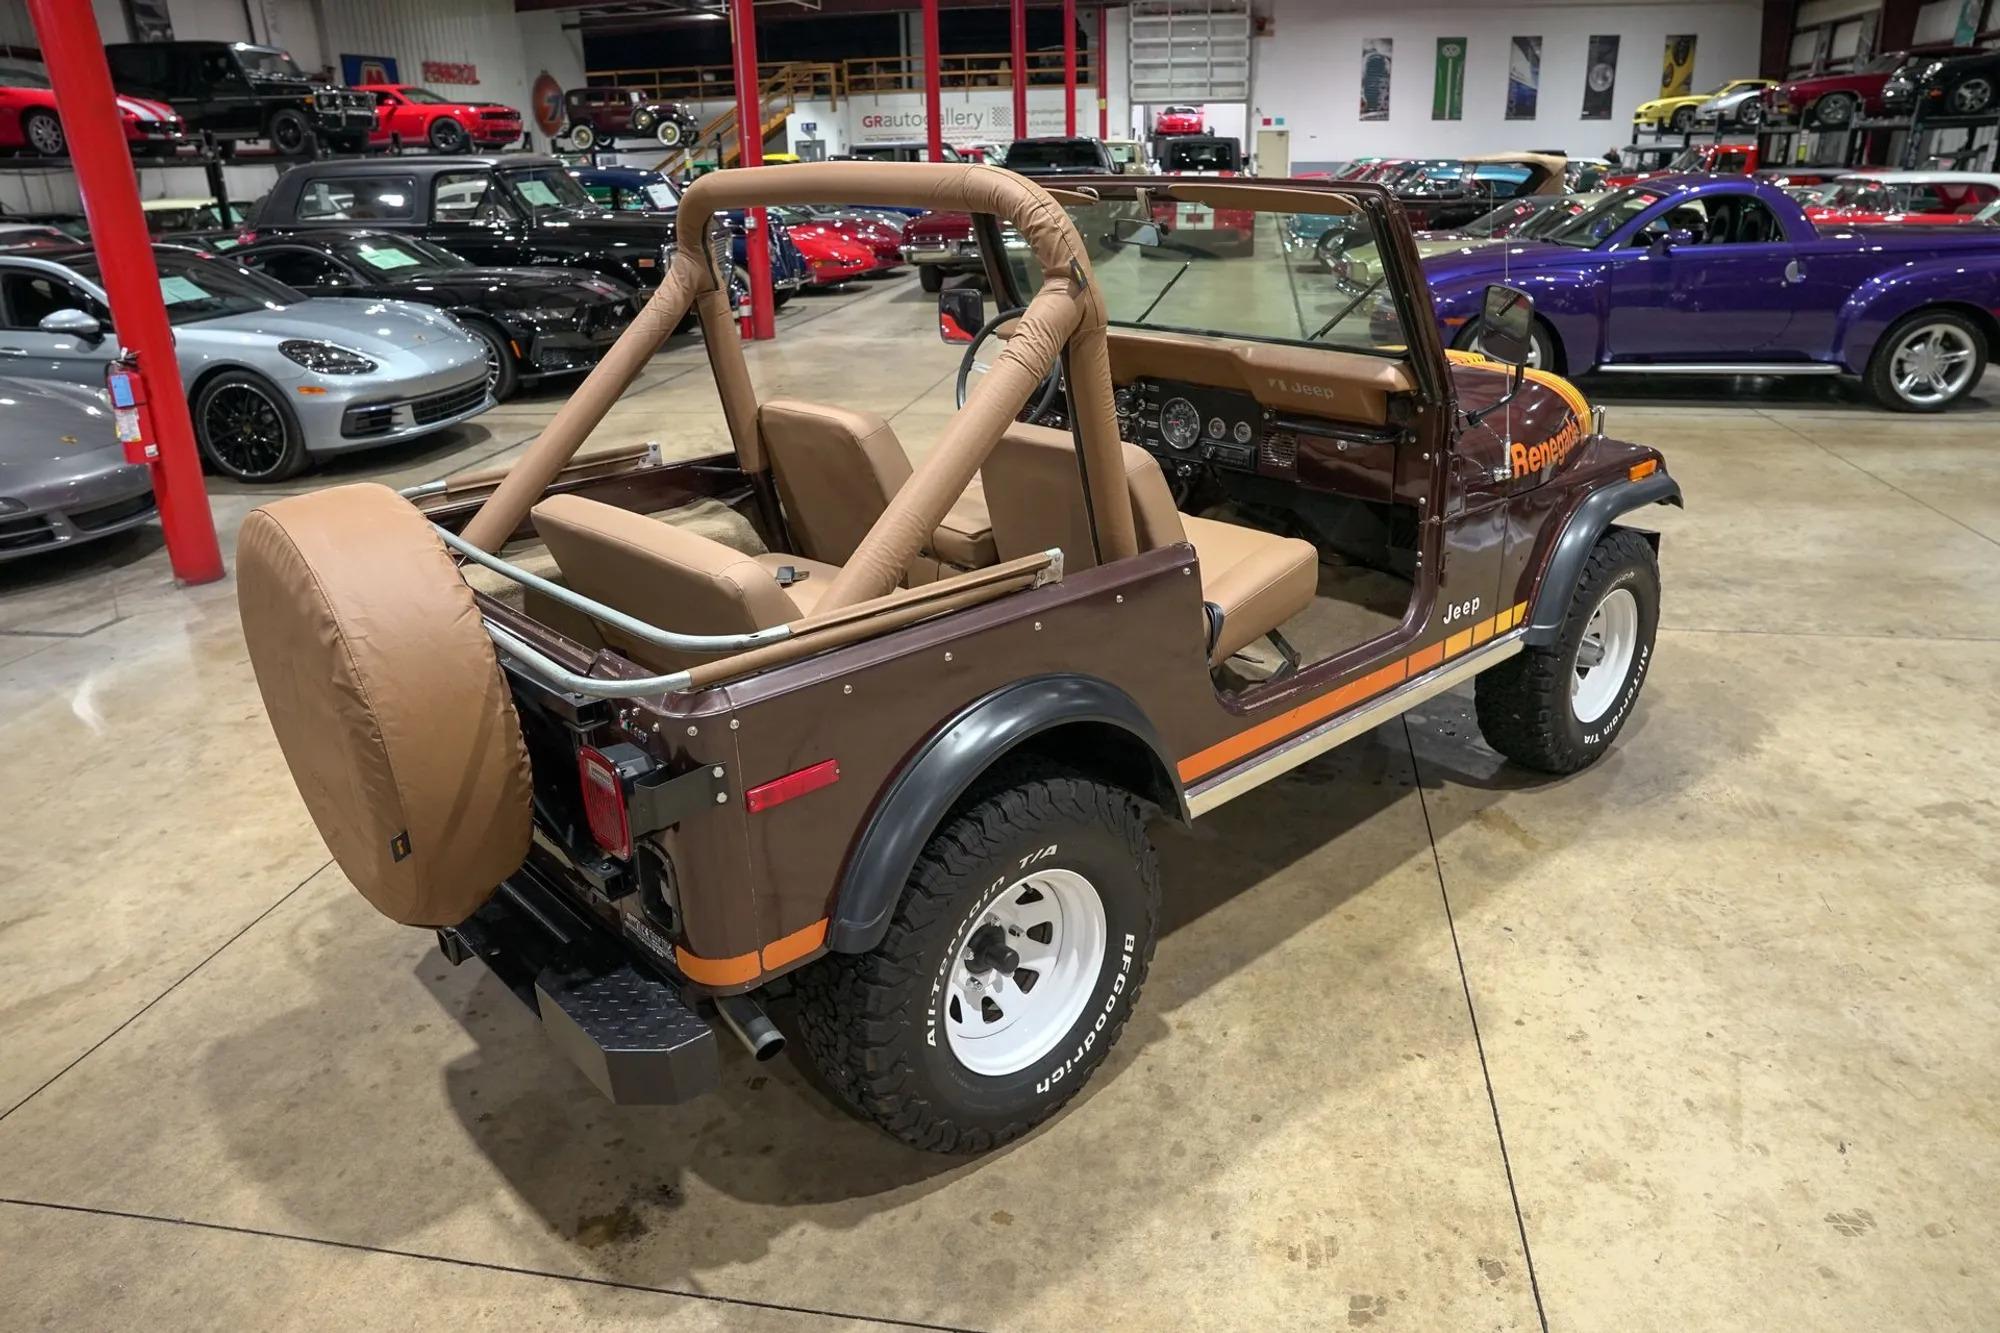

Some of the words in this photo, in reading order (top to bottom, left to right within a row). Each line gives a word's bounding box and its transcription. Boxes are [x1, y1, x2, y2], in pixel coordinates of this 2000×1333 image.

[862, 108, 984, 130] GRautollery
[1291, 382, 1335, 400] Jeep
[1443, 597, 1480, 624] Jeep
[1603, 645, 1649, 735] All-Terrain
[1584, 733, 1600, 744] T/A
[926, 876, 1005, 1047] All-Terrain
[1018, 844, 1059, 869] T/A
[1036, 933, 1136, 1095] BFGoodrich
